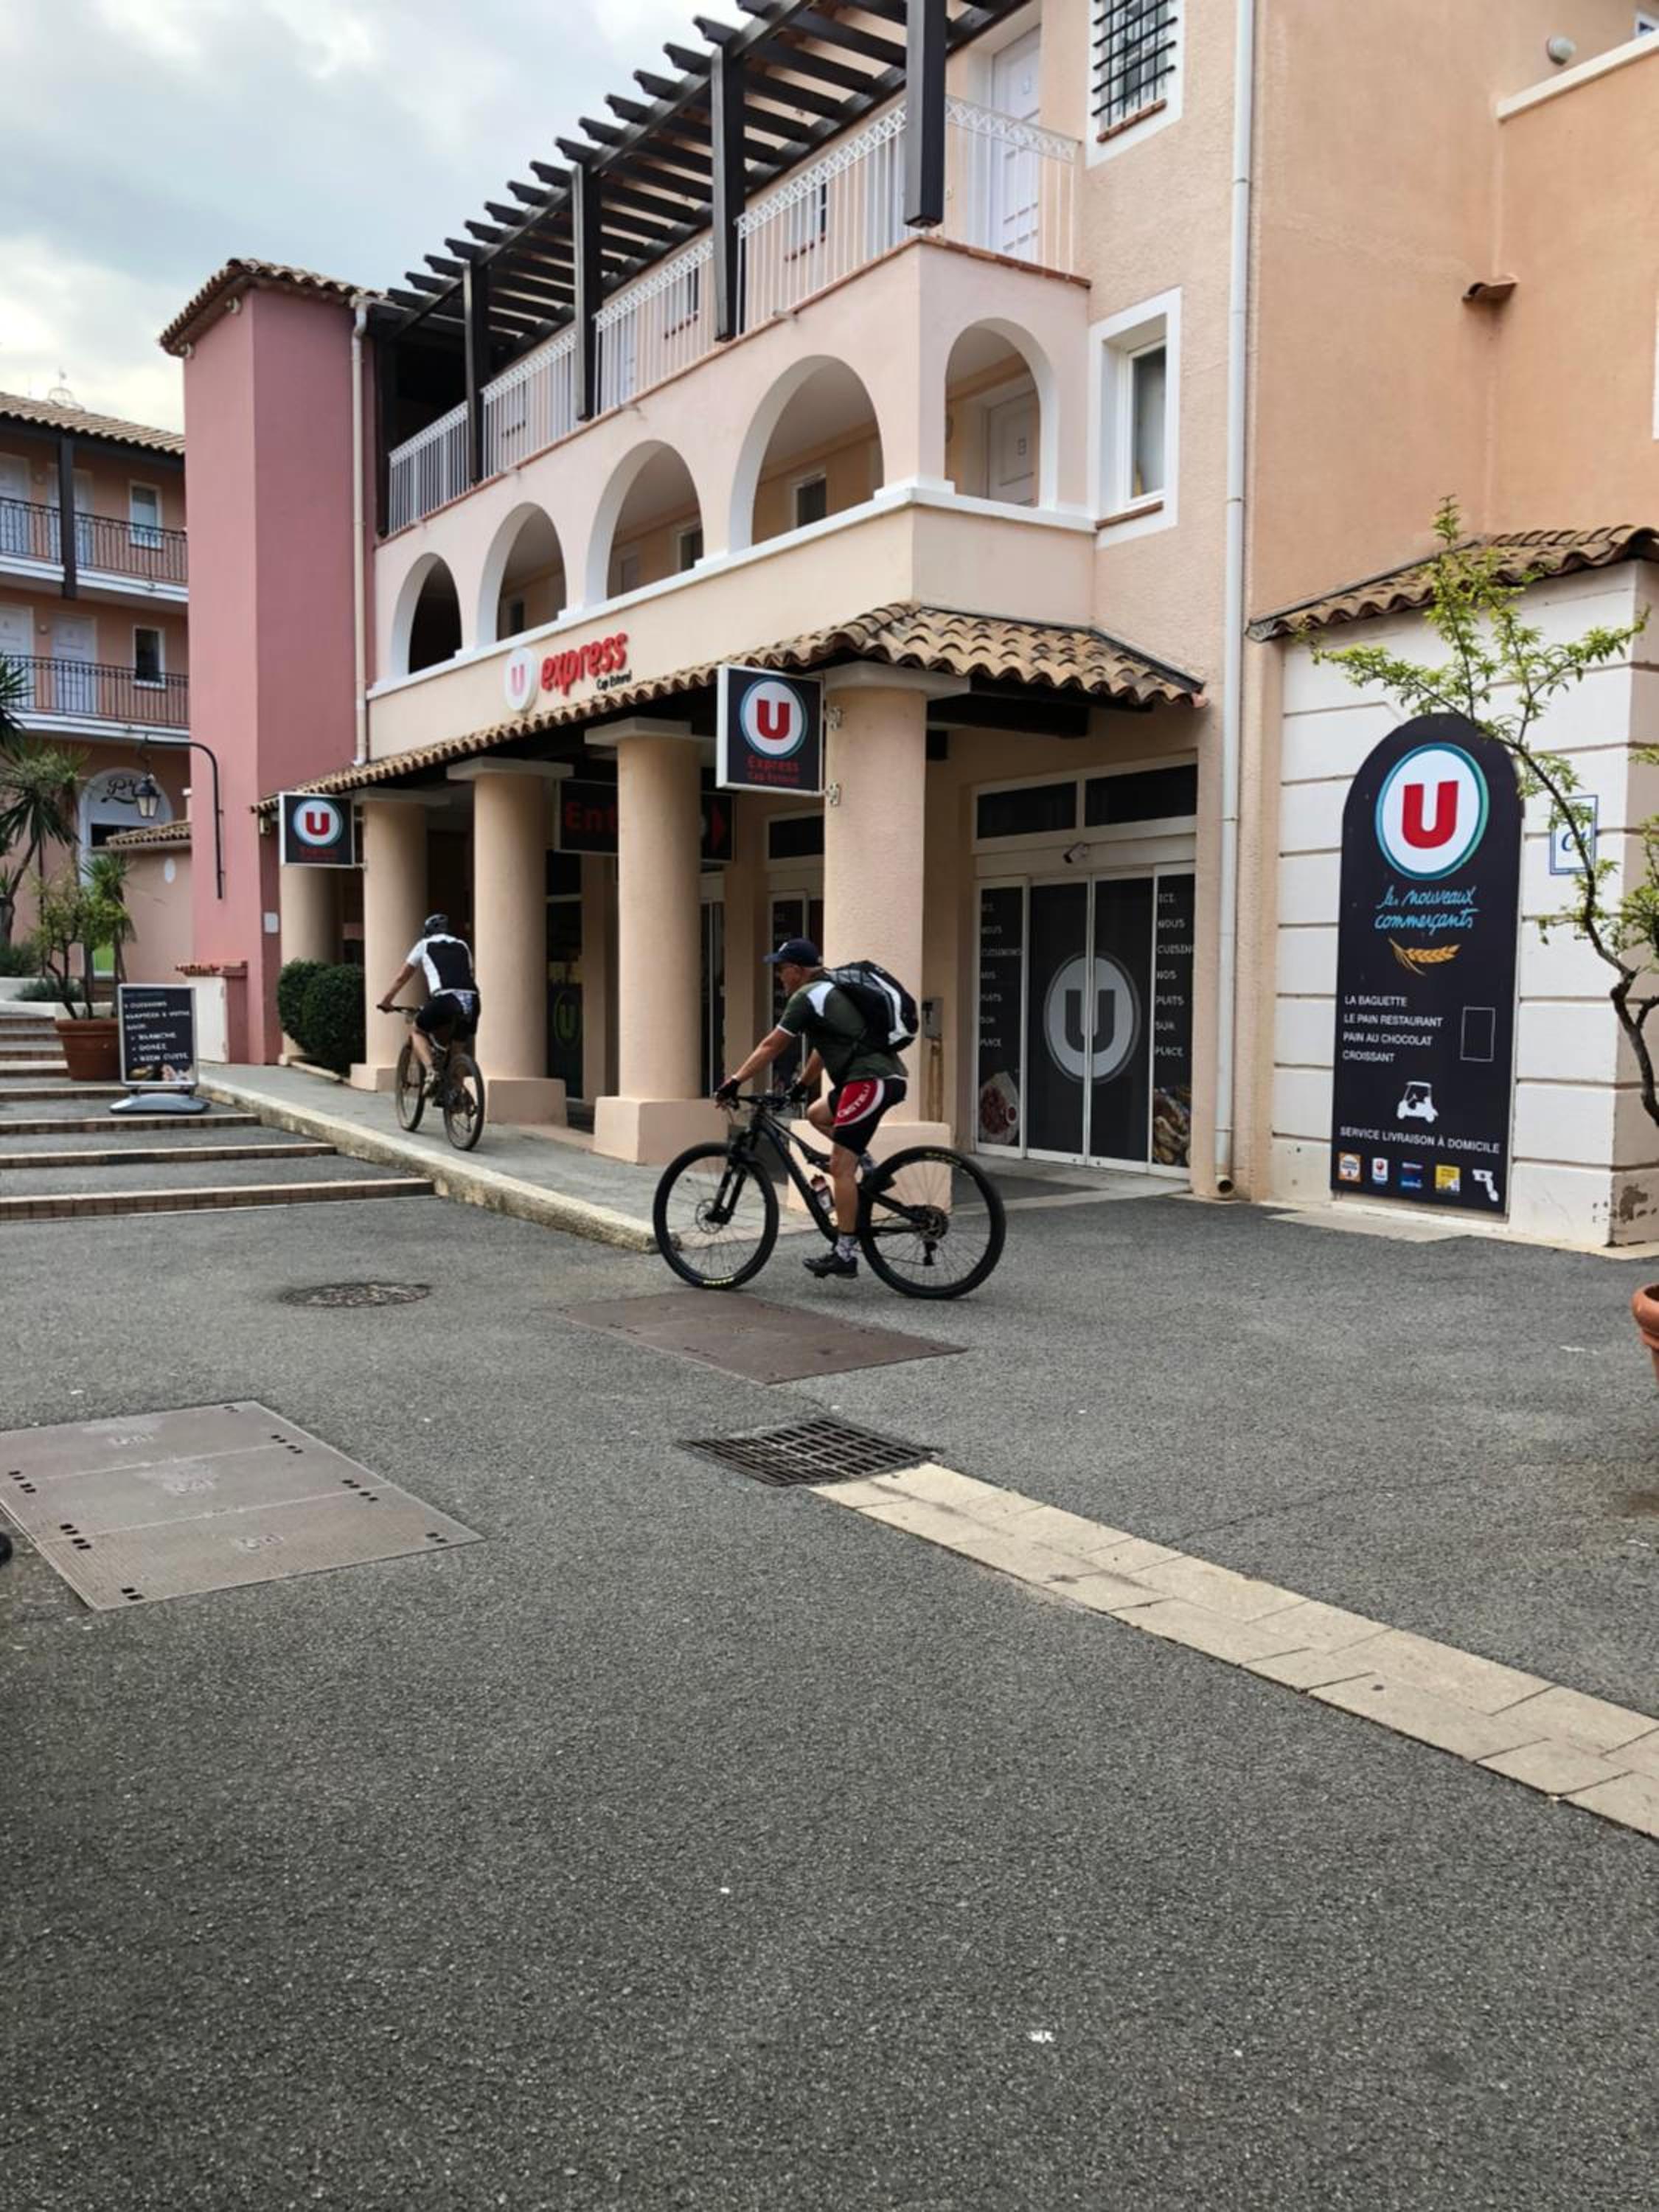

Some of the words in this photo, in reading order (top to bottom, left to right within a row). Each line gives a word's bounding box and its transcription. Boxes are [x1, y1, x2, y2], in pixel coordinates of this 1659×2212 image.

[541, 633, 628, 696] express
[757, 699, 790, 740] U
[1402, 780, 1458, 849] U
[305, 811, 330, 835] U
[1402, 886, 1476, 907] nouveaux
[1158, 919, 1185, 928] NOUS
[1374, 908, 1479, 936] commerçants
[1157, 945, 1193, 954] CUISIN
[1156, 970, 1177, 980] NOS
[1156, 996, 1184, 1006] PLATS
[1344, 995, 1356, 1005] LA
[1358, 995, 1407, 1006] BAGUETTE
[1065, 990, 1115, 1054] U
[1155, 1020, 1175, 1031] SUR
[1344, 1014, 1355, 1023] LE
[1357, 1014, 1378, 1023] PAIN
[1380, 1015, 1444, 1026] RESTAURANT
[1343, 1032, 1364, 1042] PAIN
[1366, 1033, 1379, 1043] AU
[1380, 1034, 1433, 1046] CHOCOLAT
[1155, 1046, 1183, 1057] PLACE
[1343, 1050, 1395, 1062] CROISSANT
[1340, 1127, 1380, 1140] SERVICE
[1382, 1131, 1435, 1146] LIVRAISON
[1437, 1135, 1445, 1147] À
[1447, 1138, 1500, 1154] DOMICILE
